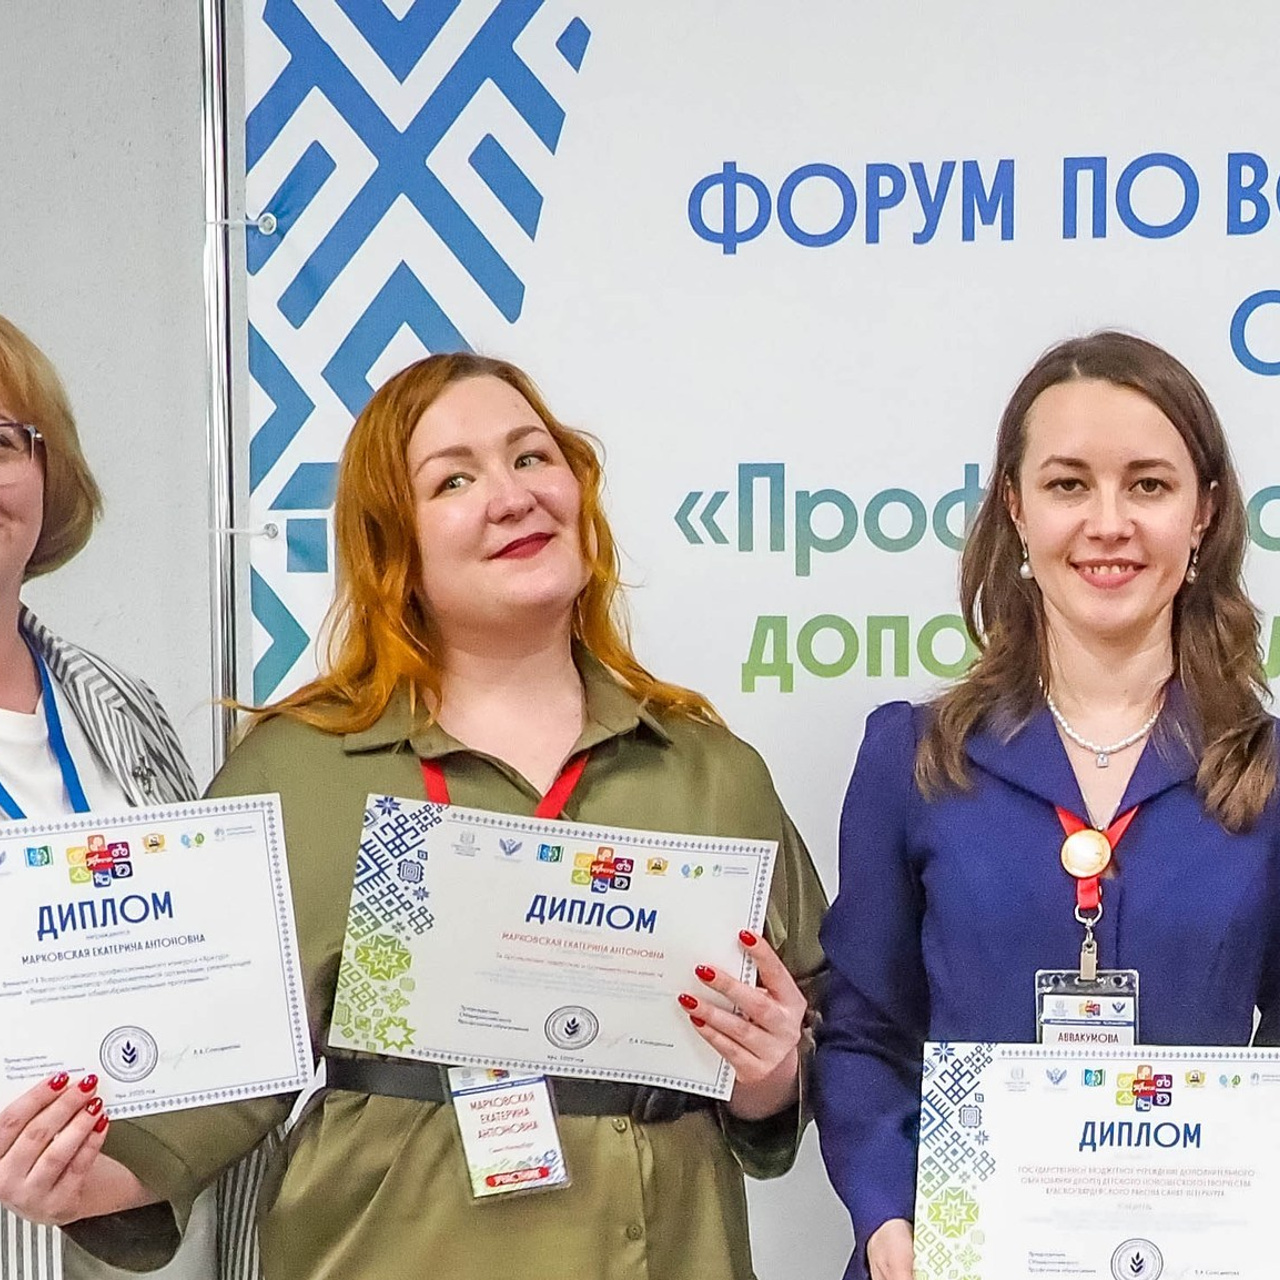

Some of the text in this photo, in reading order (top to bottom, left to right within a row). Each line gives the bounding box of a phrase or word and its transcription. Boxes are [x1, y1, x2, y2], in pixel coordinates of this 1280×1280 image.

[687, 159, 1014, 255] ФОРУМ
[1062, 152, 1200, 240] ПО
[37, 891, 174, 941] ДИПЛОМ
[525, 894, 658, 934] ДИПЛОМ
[22, 933, 206, 965] МАРКОВСКАЯ ЕКАТЕРИНА АНТОНОВНА
[502, 932, 665, 960] МАРКОВСКАЯ ЕКАТЕРИНА АНТОНОВНА
[1057, 1032, 1119, 1043] АВВАКУМОВА
[470, 1091, 535, 1110] МАРКОВСКАЯ
[477, 1121, 539, 1139] АНТОНОВНА
[480, 1108, 530, 1124] ЕКАТЕРИНА
[1078, 1120, 1201, 1152] ДИПЛОМ
